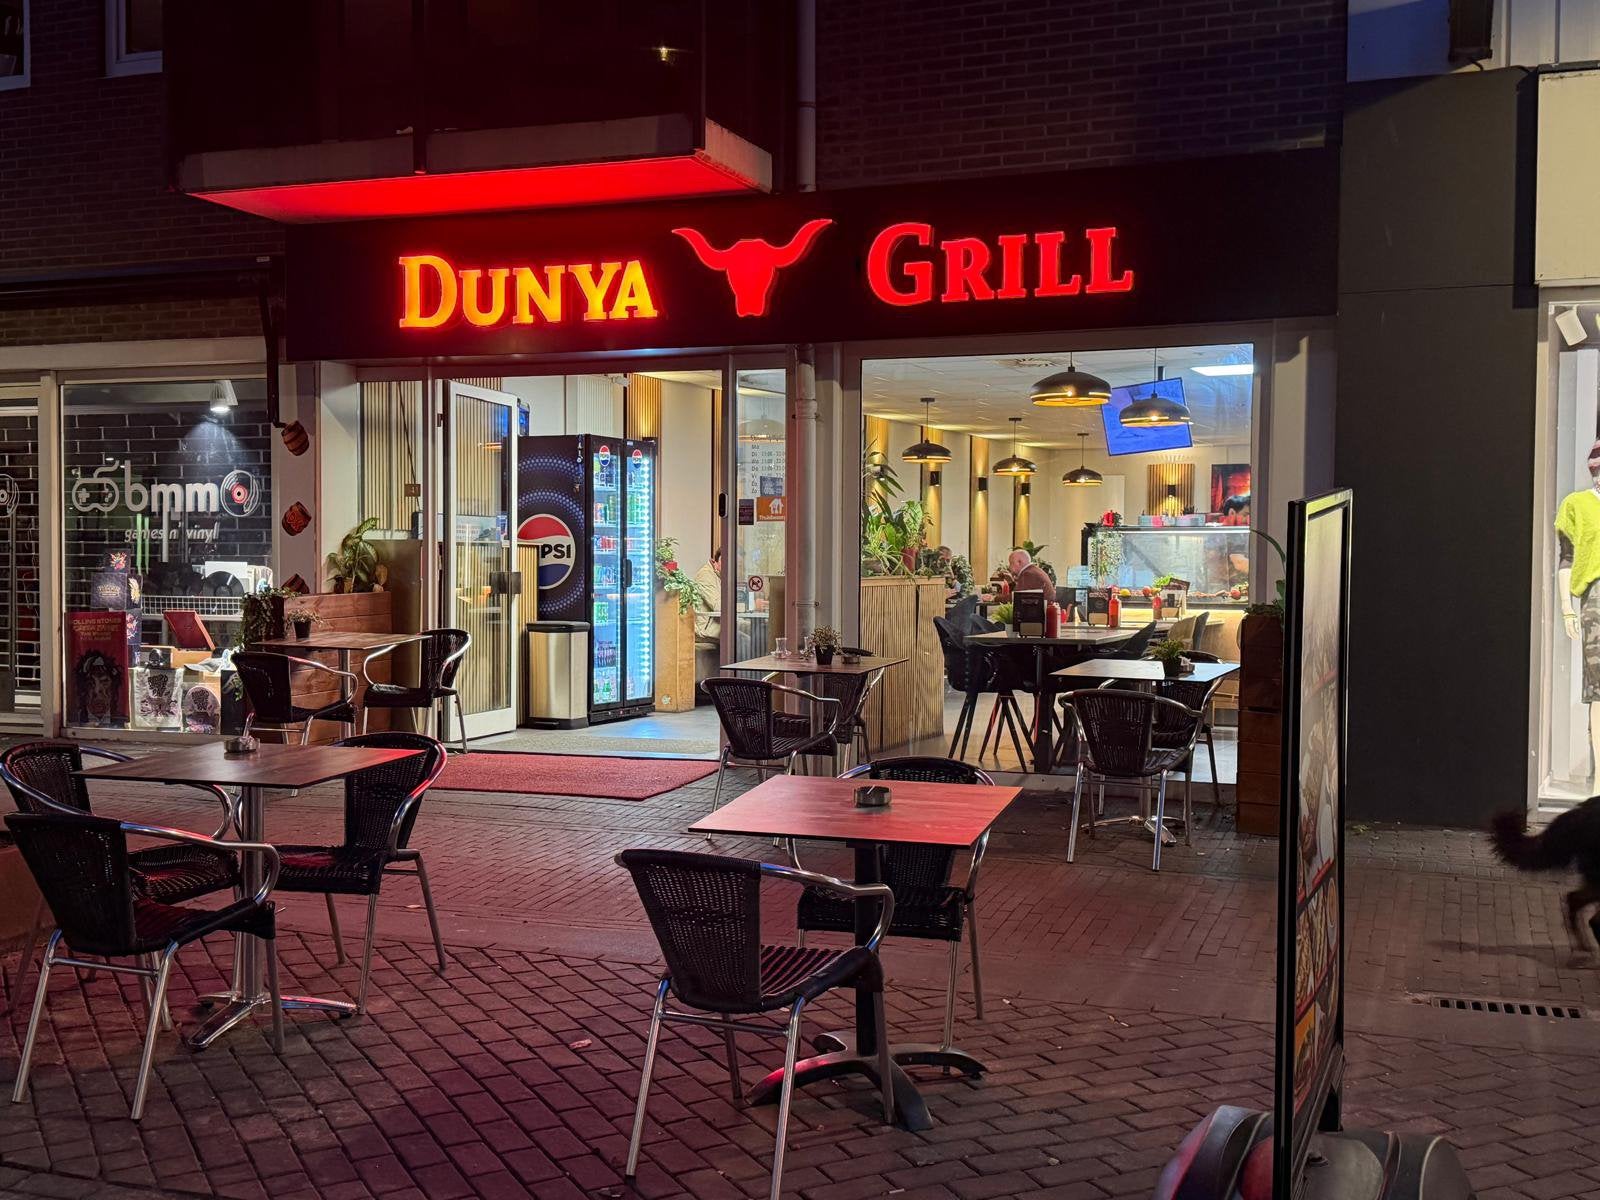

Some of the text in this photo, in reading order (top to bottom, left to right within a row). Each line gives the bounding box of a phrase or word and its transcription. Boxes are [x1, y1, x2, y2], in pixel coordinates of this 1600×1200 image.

[399, 222, 1134, 328] DUNYA GRILL
[124, 527, 166, 543] games
[186, 522, 220, 544] vinyl
[541, 543, 572, 559] PSI
